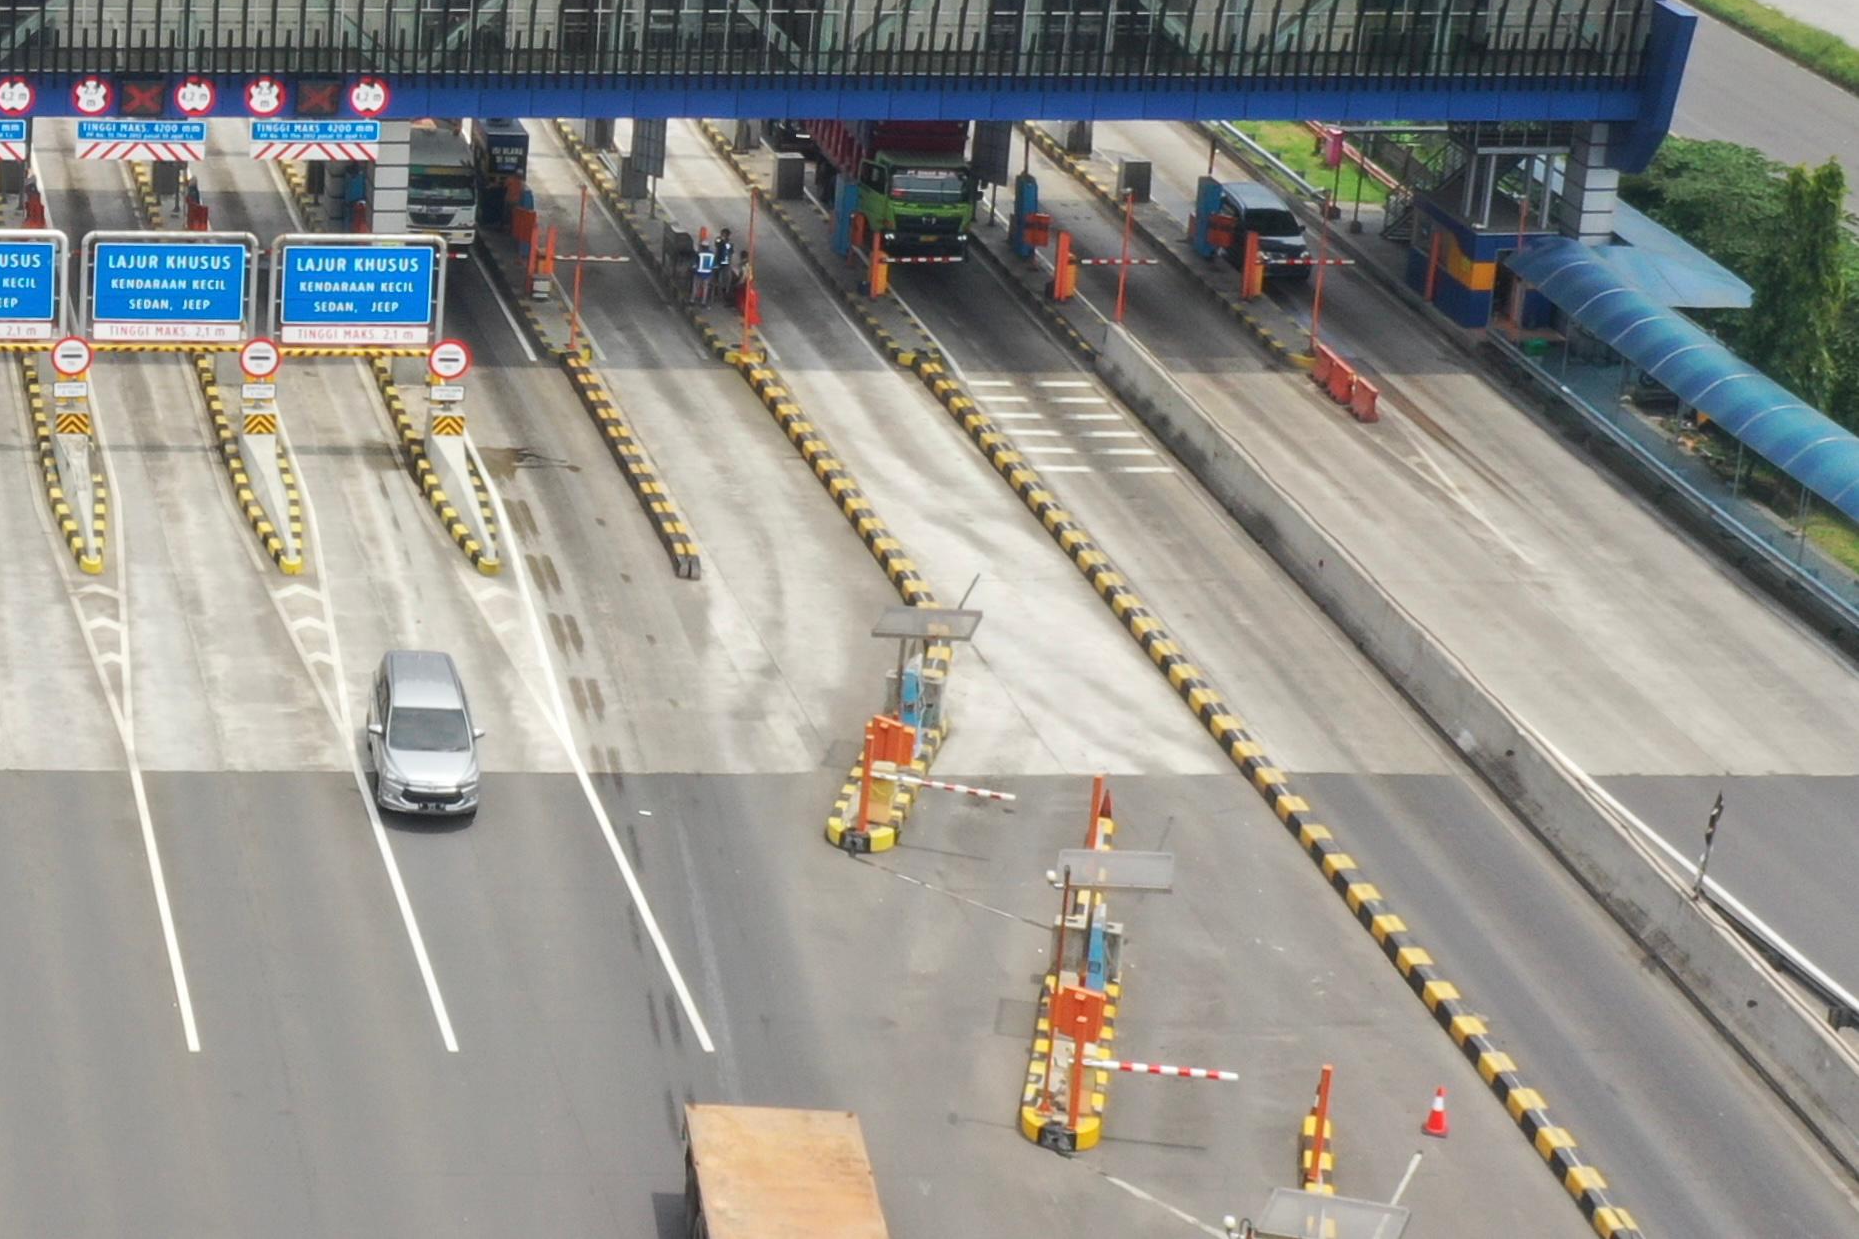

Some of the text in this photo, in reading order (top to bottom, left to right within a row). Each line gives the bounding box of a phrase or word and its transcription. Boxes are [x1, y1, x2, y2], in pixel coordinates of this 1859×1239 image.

[19, 92, 27, 100] m
[199, 92, 208, 101] m
[373, 93, 382, 101] m
[83, 123, 116, 131] TINGGI
[154, 123, 178, 132] 4200
[182, 124, 201, 132] mm
[257, 123, 290, 132] TINGGI
[328, 123, 351, 132] 4200
[109, 255, 231, 269] LAJUR KHUSUS
[297, 258, 418, 272] LAJUR KHUSUS
[3, 278, 35, 288] KECIL
[111, 279, 225, 290] KENDARAAN KECIL
[300, 282, 413, 292] KENDARAAN KECIL
[129, 299, 210, 310] SEDAN, JEEP
[314, 301, 399, 312] SEDAN, JEEP
[7, 325, 21, 336] 2,1
[26, 327, 36, 335] m
[109, 326, 149, 336] TINGGI
[156, 326, 190, 336] MAKS.
[196, 326, 209, 337] 2,1
[298, 329, 413, 340] TINGGI MAKS. 2,1 m
